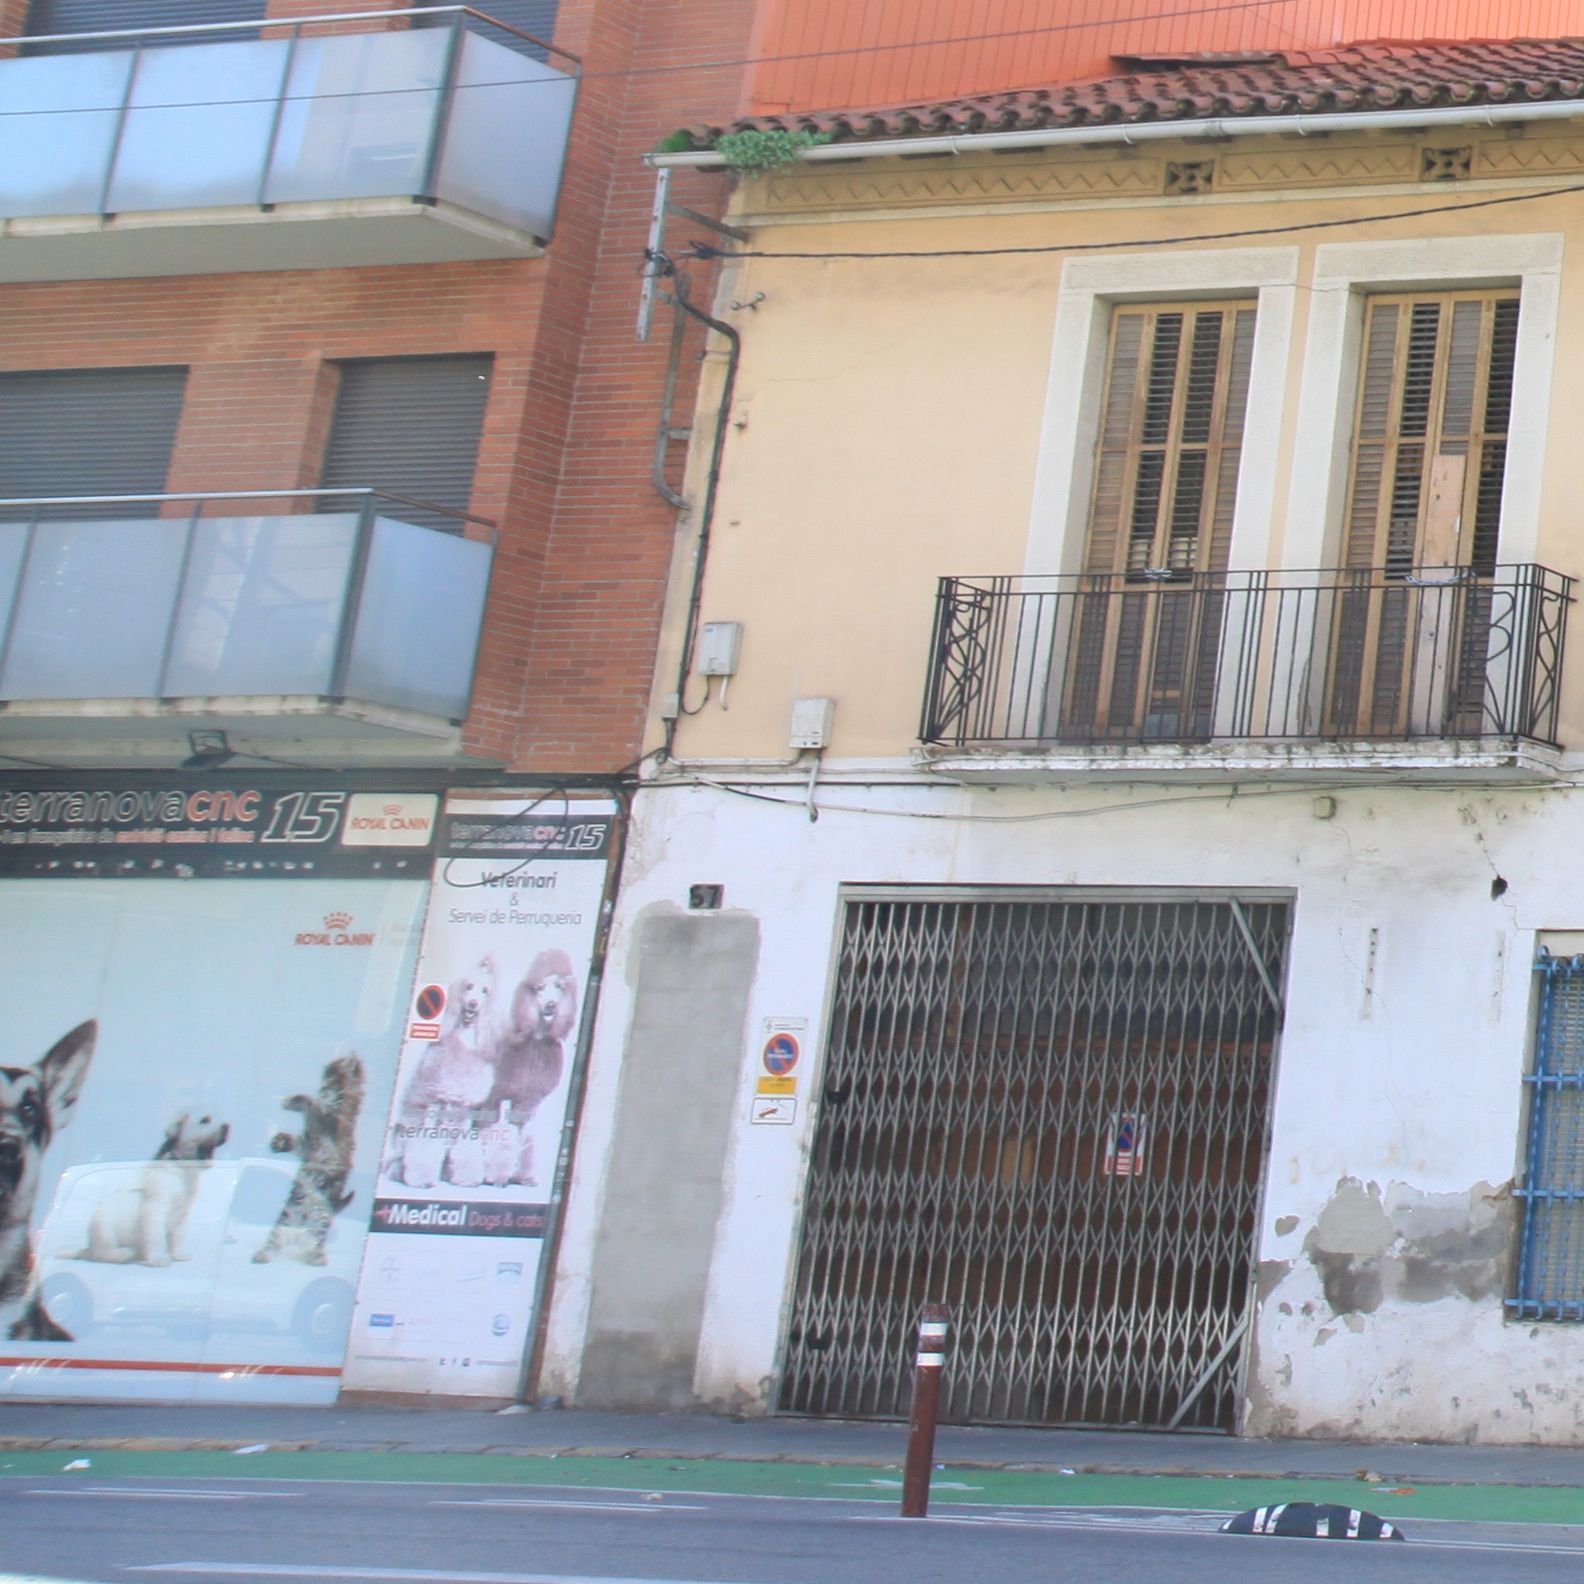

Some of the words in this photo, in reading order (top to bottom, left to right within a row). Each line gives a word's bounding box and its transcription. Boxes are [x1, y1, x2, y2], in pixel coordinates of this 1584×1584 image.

[260, 792, 347, 842] 15
[352, 818, 386, 830] ROYAL
[390, 818, 430, 830] CANIN
[564, 824, 607, 850] 15
[481, 872, 558, 889] Veterinari
[509, 892, 520, 906] &
[448, 908, 487, 924] Servei
[489, 909, 502, 924] de
[295, 933, 332, 946] ROYAL
[334, 933, 375, 946] CANIN
[468, 1211, 500, 1230] Dogs
[502, 1212, 513, 1227] &
